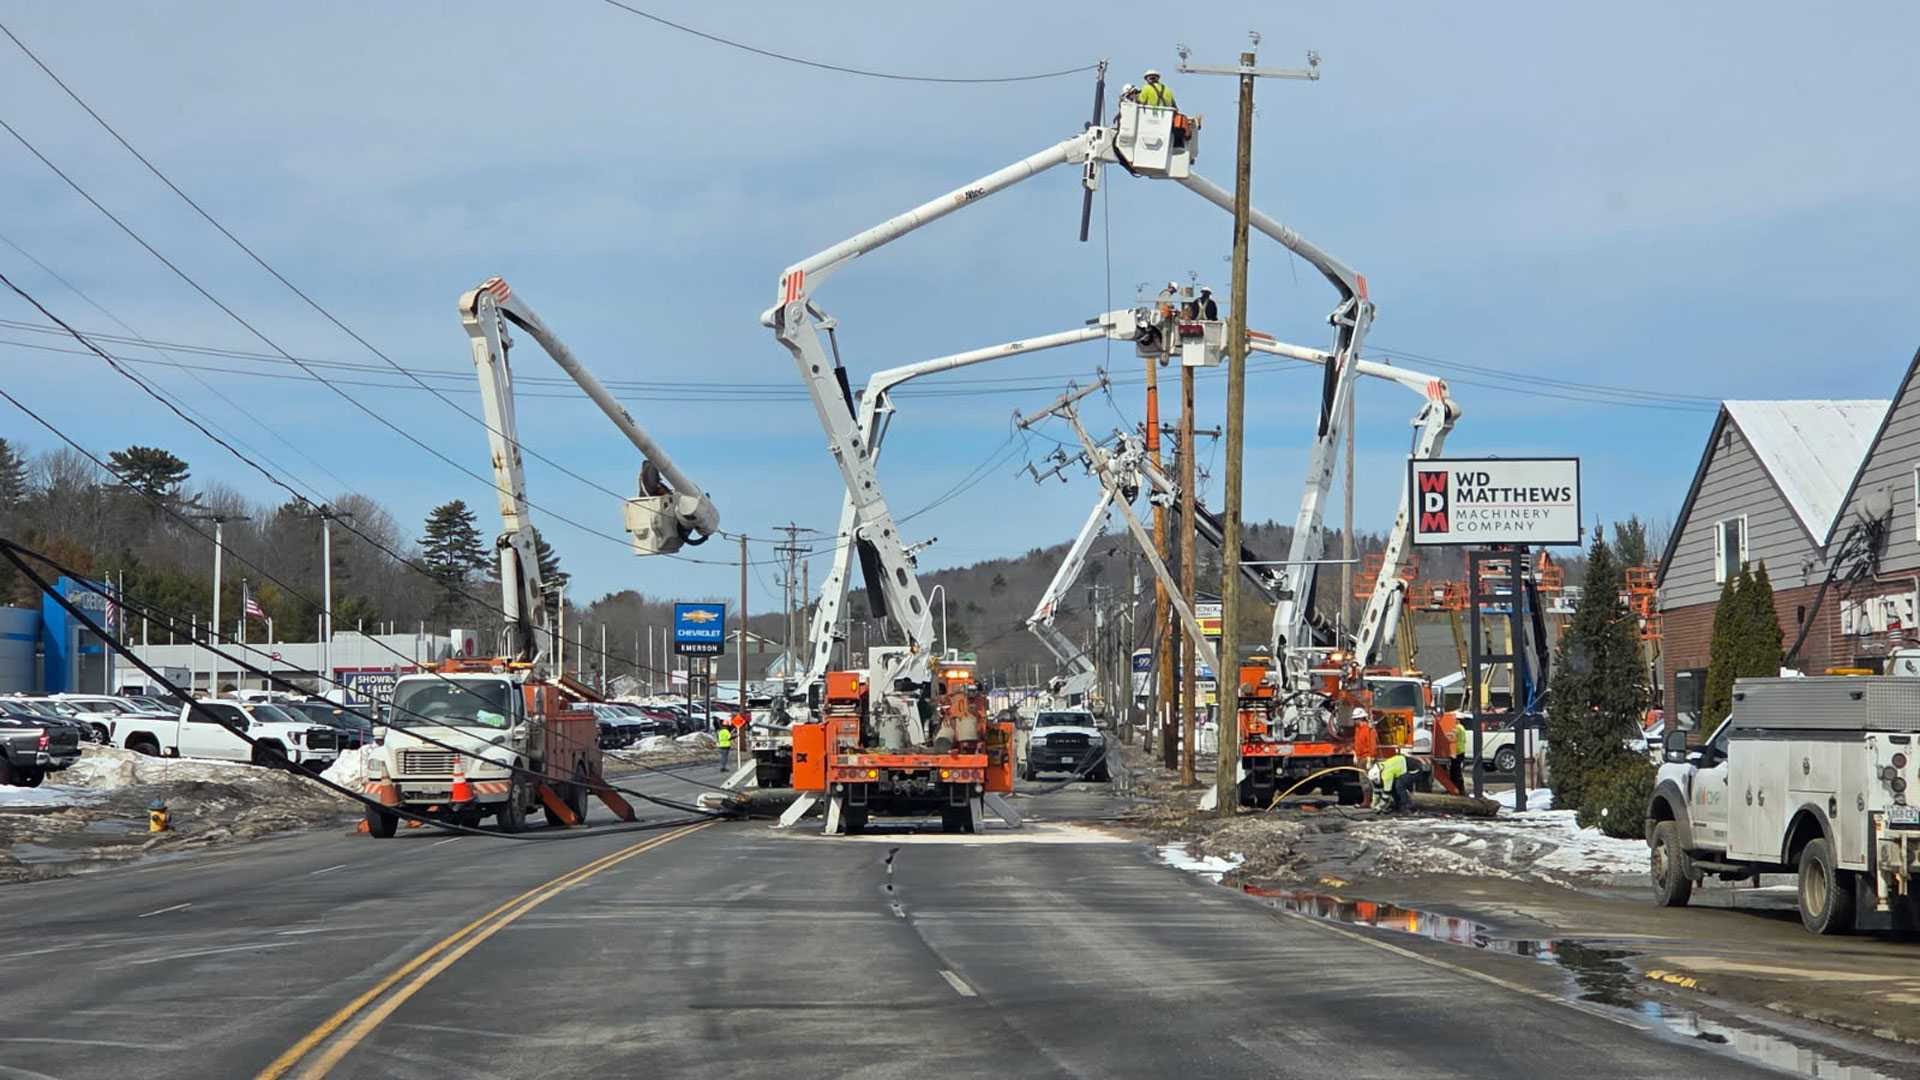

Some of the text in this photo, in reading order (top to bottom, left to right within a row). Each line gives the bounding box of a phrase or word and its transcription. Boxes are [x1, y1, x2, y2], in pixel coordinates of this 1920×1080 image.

[1456, 472, 1490, 487] WD
[1456, 487, 1572, 503] MATTHEWS
[1419, 472, 1448, 532] WDM
[1456, 509, 1550, 520] MACHINERY
[1456, 521, 1535, 532] COMPANY
[681, 644, 718, 652] EMERSON
